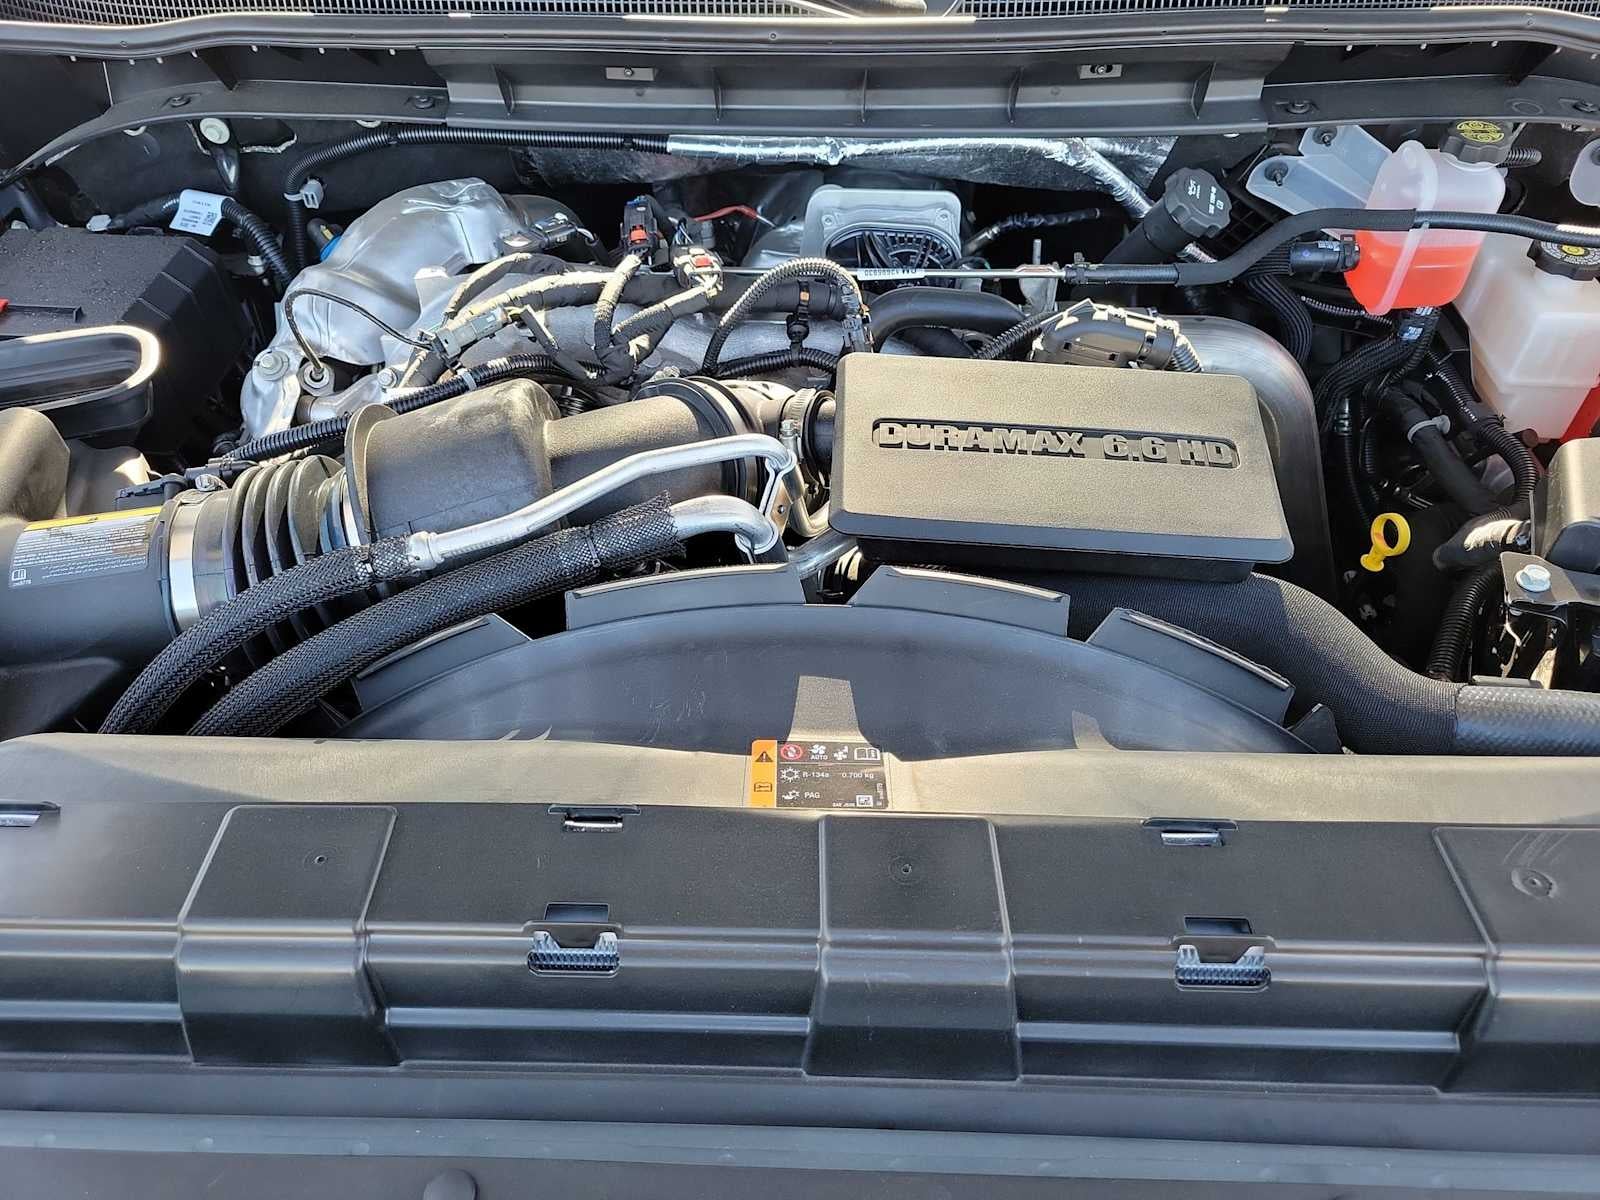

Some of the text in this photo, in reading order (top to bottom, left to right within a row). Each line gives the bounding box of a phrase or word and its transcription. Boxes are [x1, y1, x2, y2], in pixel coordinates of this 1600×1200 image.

[879, 422, 1233, 467] DURAMAX 6.6 HD
[864, 772, 875, 780] kg
[804, 791, 821, 799] PAG
